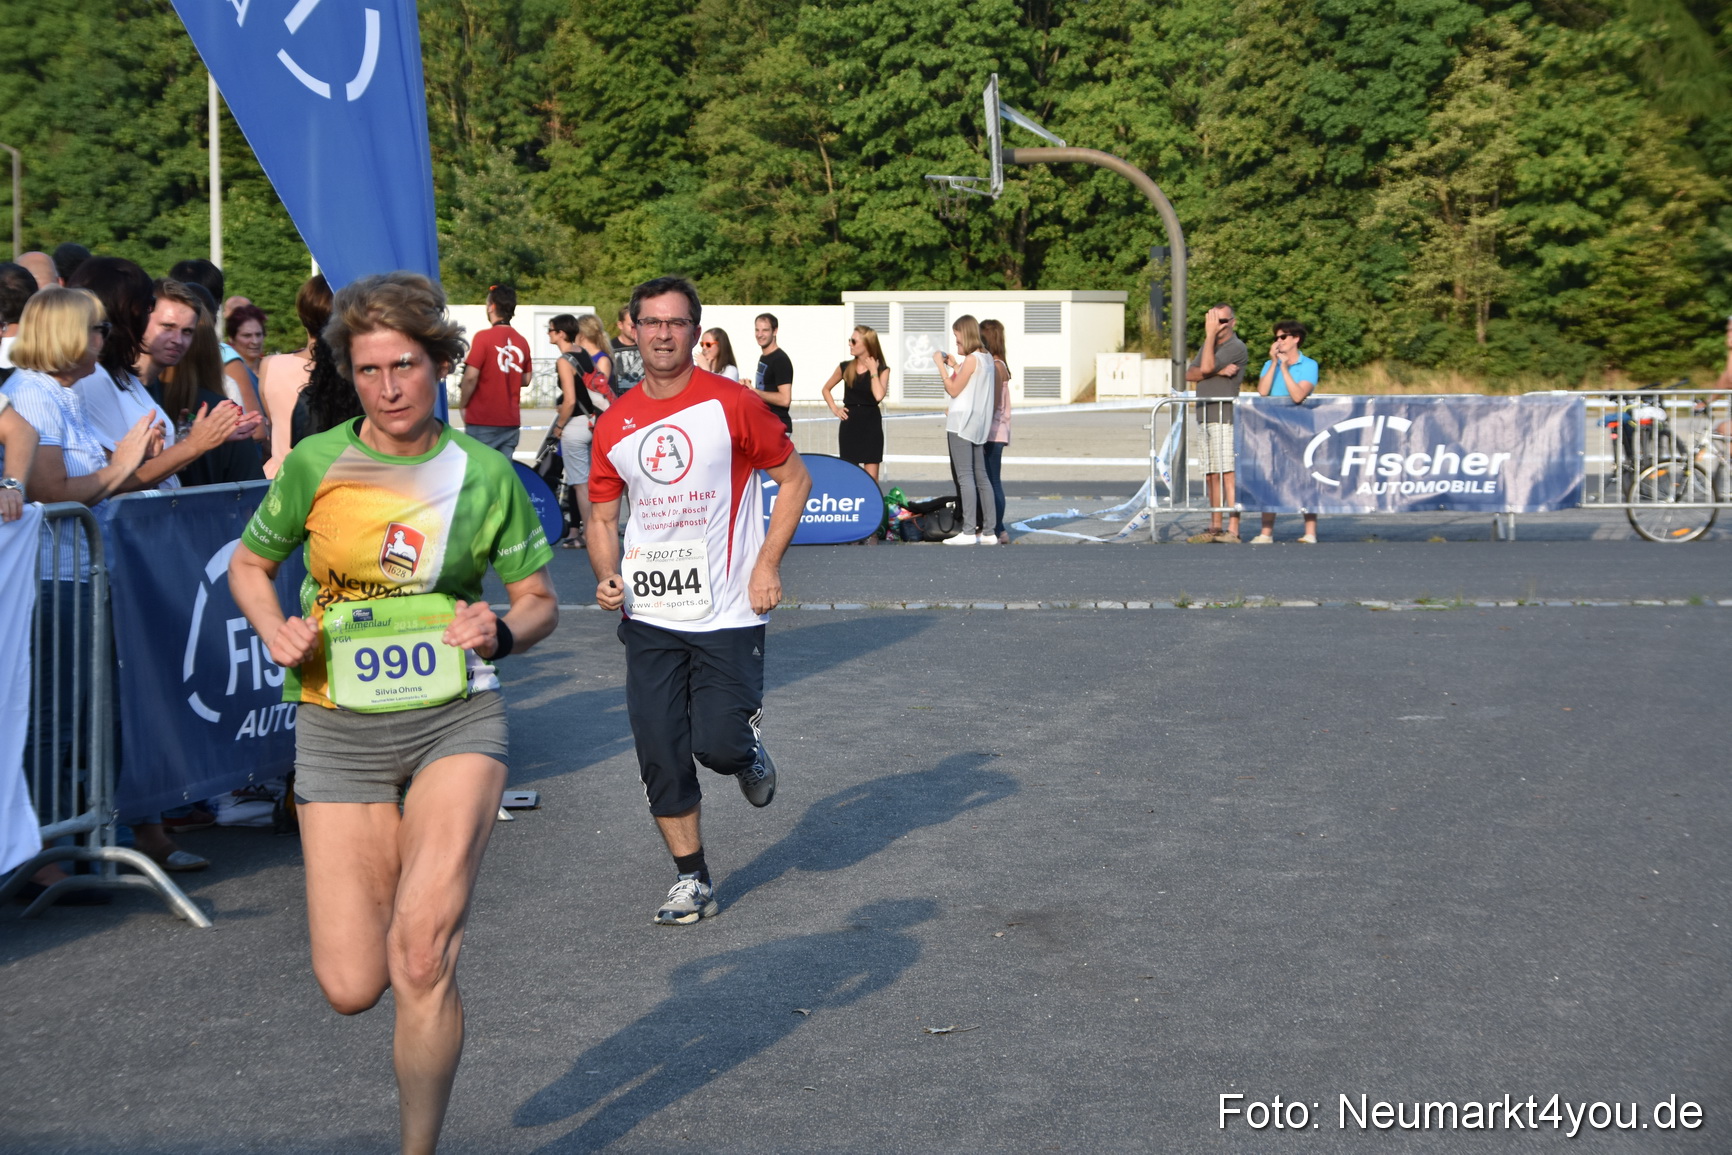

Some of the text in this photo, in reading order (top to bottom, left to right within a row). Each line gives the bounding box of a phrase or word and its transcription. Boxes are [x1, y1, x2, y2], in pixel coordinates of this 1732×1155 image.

[1341, 443, 1511, 477] Fischer
[1356, 480, 1497, 495] AUTOMOBILE
[638, 490, 716, 507] AUFEN MIT HERZ
[769, 493, 866, 513] Fcher
[682, 505, 708, 514] Röschl
[799, 513, 860, 523] TOMOBILE
[625, 546, 693, 561] df-sports
[387, 564, 407, 578] 1628
[632, 567, 702, 597] 8944
[628, 598, 709, 610] www.df-sports.de
[344, 617, 392, 631] firmenlauf
[354, 641, 436, 682] 990
[375, 686, 422, 696] Silvia Ohms
[235, 702, 298, 741] AUTO
